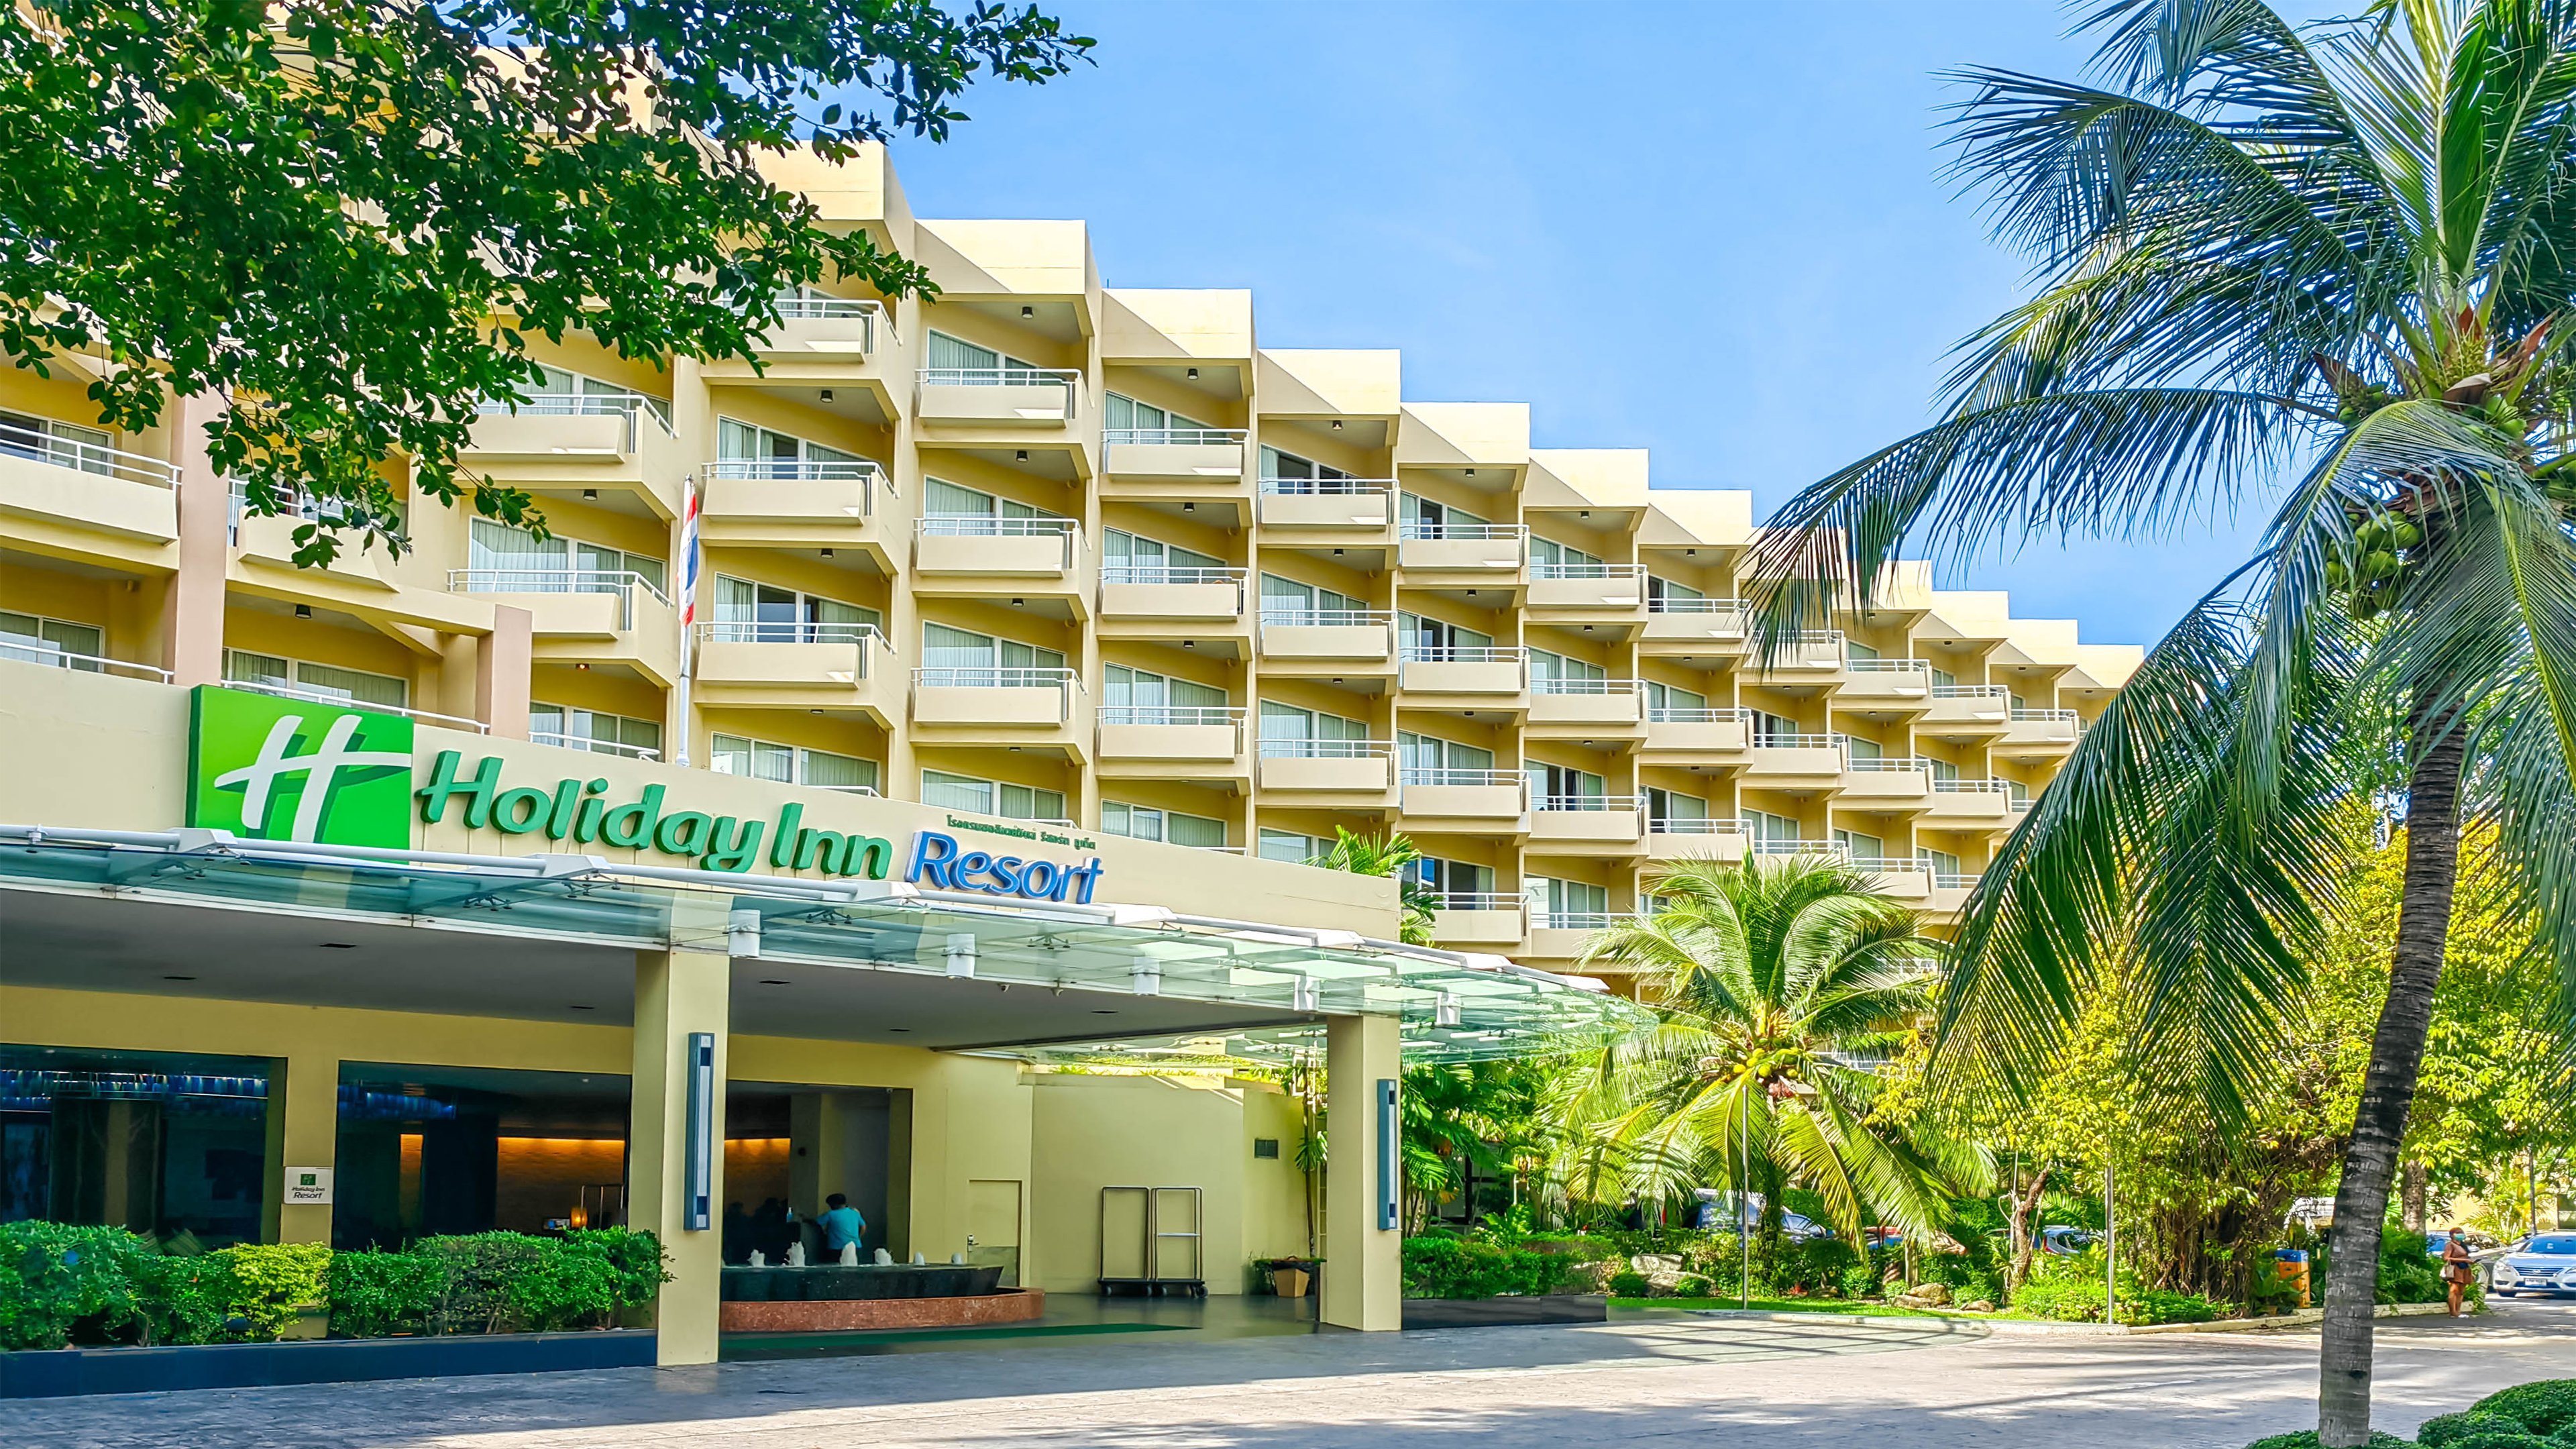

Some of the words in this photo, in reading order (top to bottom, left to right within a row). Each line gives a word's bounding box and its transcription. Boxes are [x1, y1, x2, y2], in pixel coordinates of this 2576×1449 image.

[414, 750, 766, 873] Holiday
[769, 802, 893, 880] Inn
[904, 830, 1105, 904] Resort
